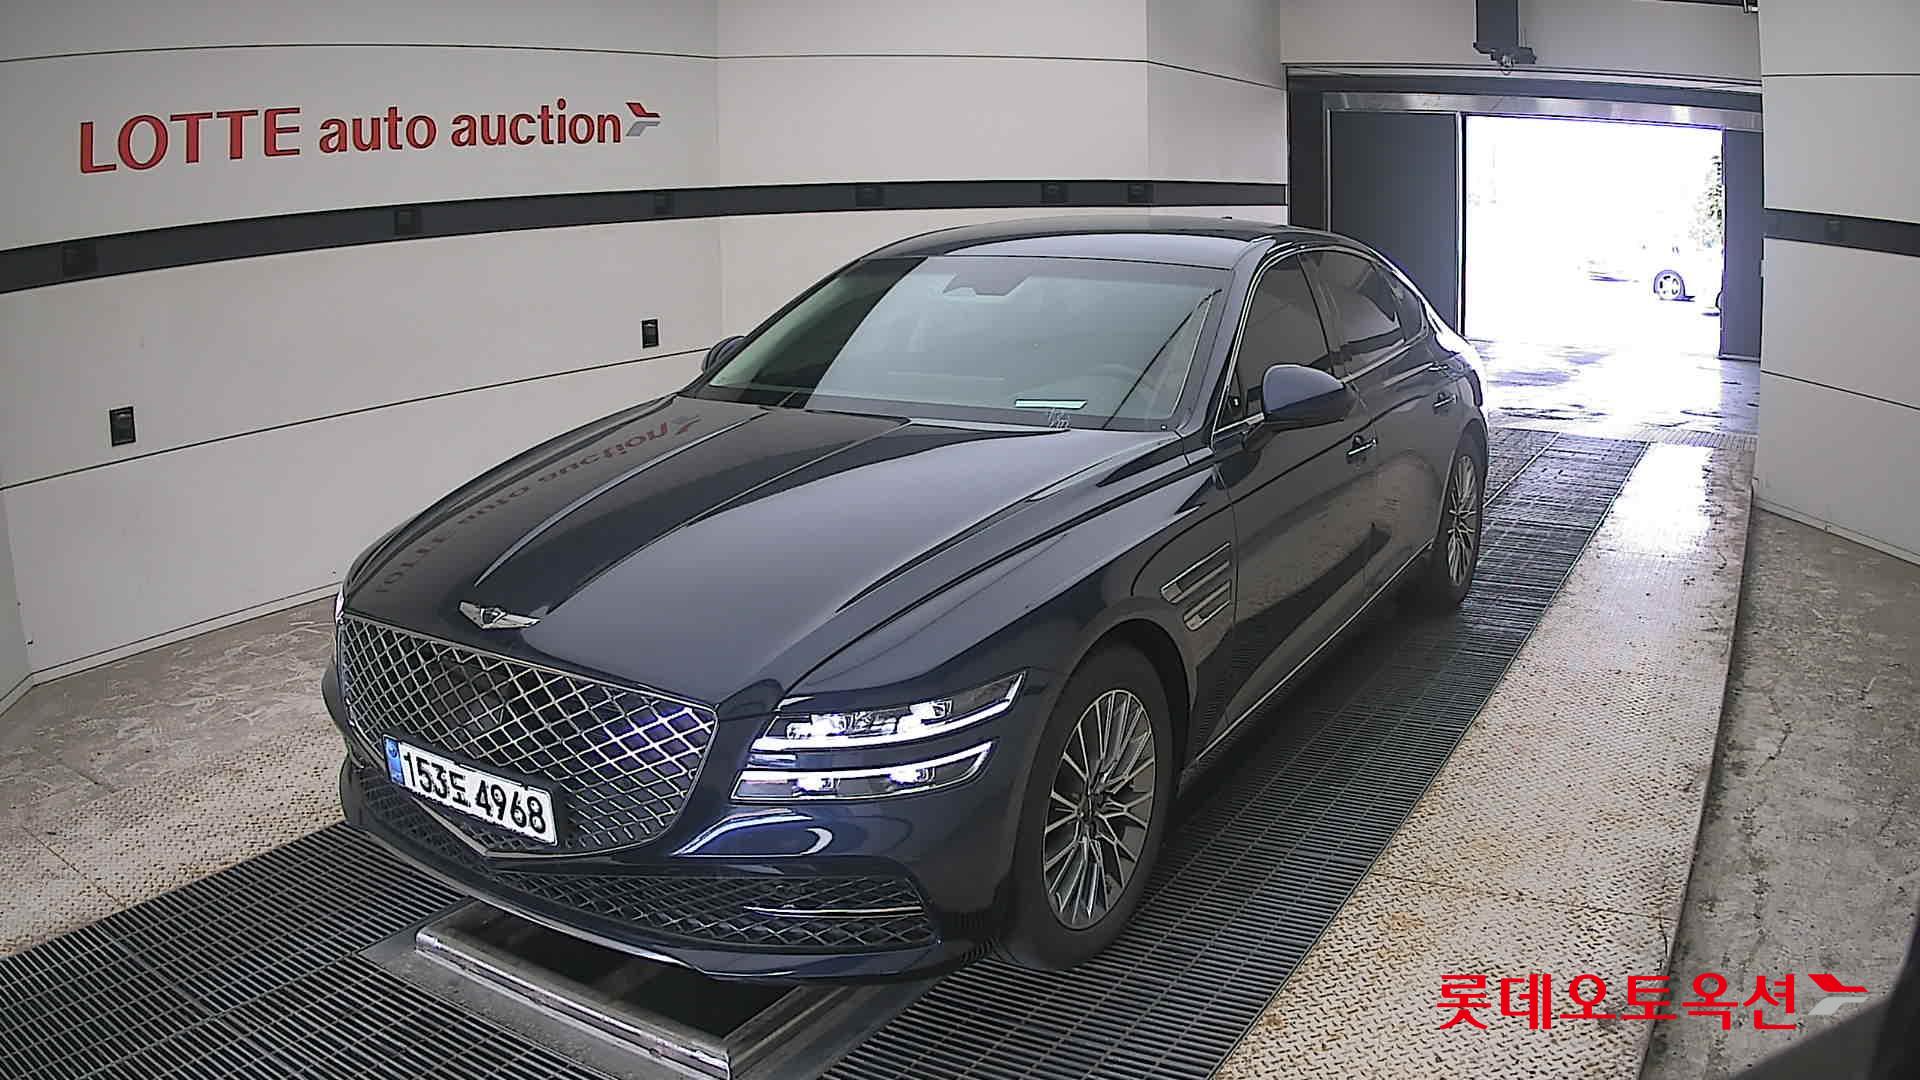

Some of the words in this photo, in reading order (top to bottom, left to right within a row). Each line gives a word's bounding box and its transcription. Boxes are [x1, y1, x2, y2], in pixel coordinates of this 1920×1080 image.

[79, 107, 301, 174] LOTTE
[320, 105, 438, 155] auto
[451, 98, 623, 148] auction
[475, 779, 547, 834] 4968
